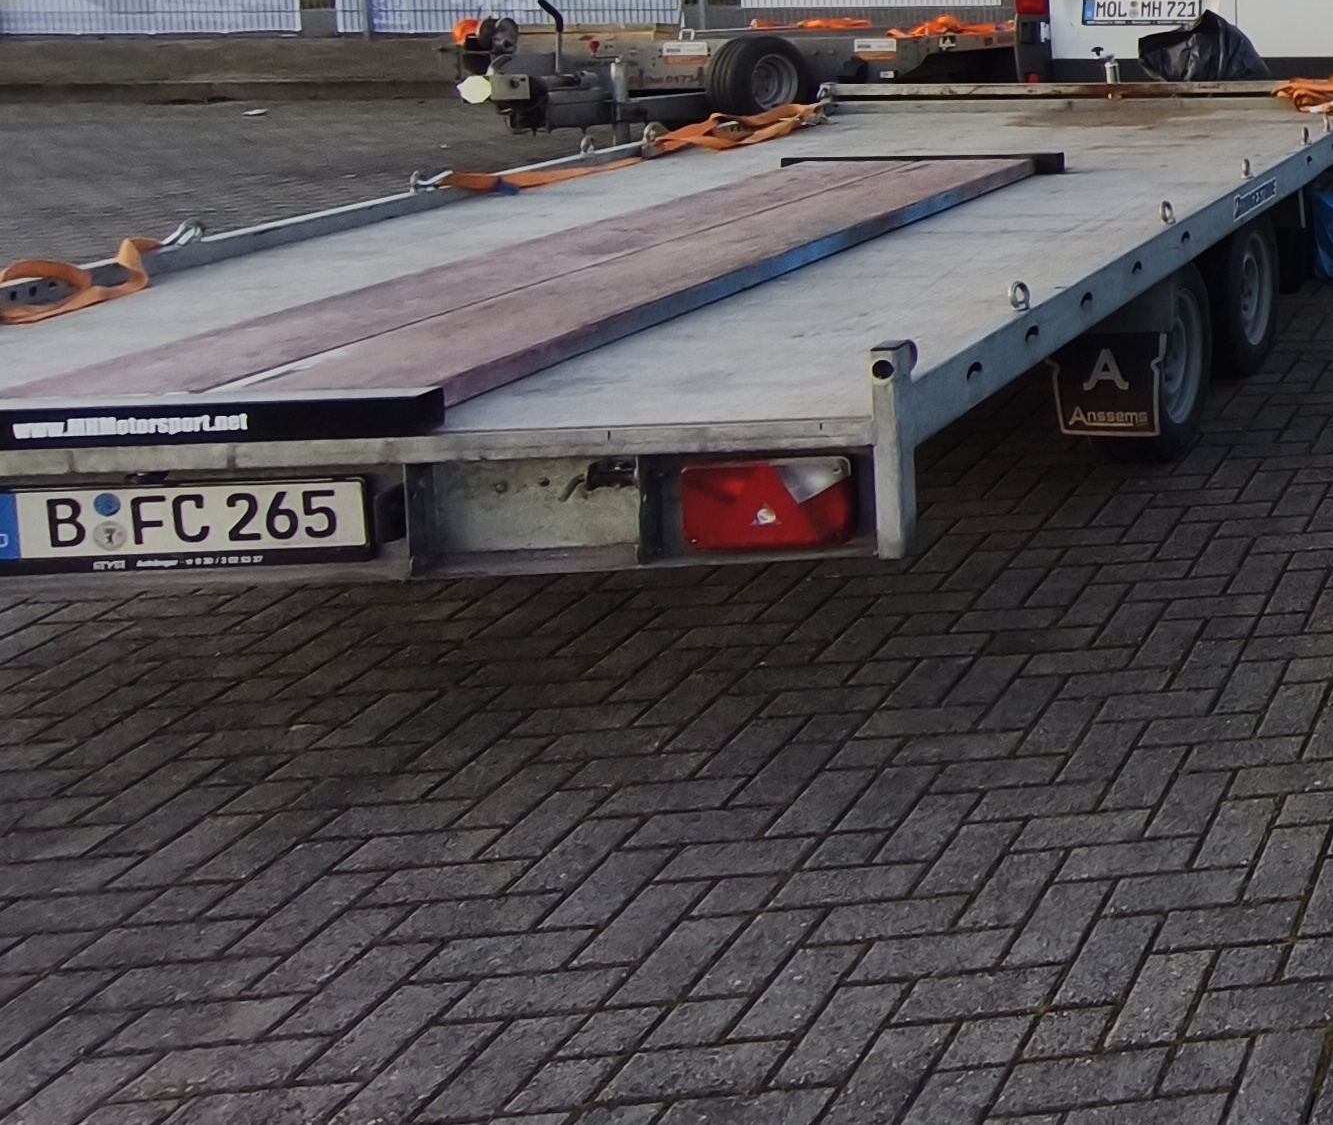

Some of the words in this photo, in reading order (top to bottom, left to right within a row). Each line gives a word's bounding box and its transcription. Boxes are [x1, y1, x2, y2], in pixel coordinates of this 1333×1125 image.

[1095, 0, 1127, 19] MOL
[1141, 0, 1162, 19] MH
[1166, 0, 1197, 18] 721
[1083, 347, 1129, 391] A
[12, 413, 248, 440] www.MHMotorsport.net
[1068, 405, 1149, 427] Anssems
[46, 497, 86, 548] B
[130, 493, 210, 546] FC
[226, 489, 338, 542] 265
